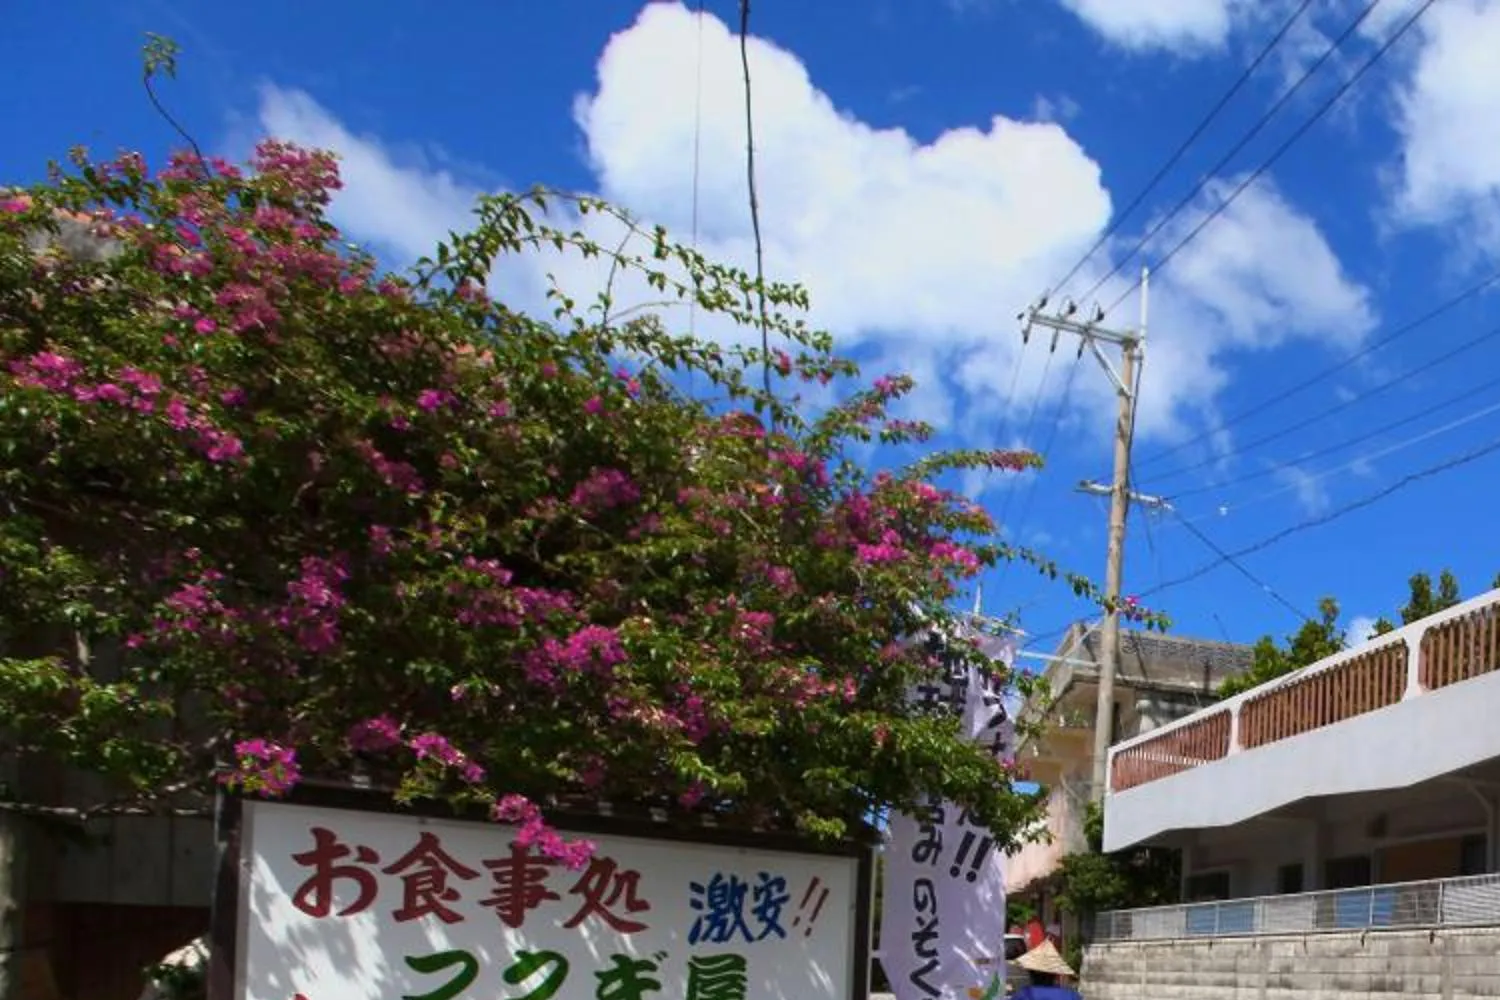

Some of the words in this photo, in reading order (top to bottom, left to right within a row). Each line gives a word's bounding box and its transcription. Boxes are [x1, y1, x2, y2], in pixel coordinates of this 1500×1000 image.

[292, 827, 652, 935] お食事処
[688, 871, 830, 946] 激安!!
